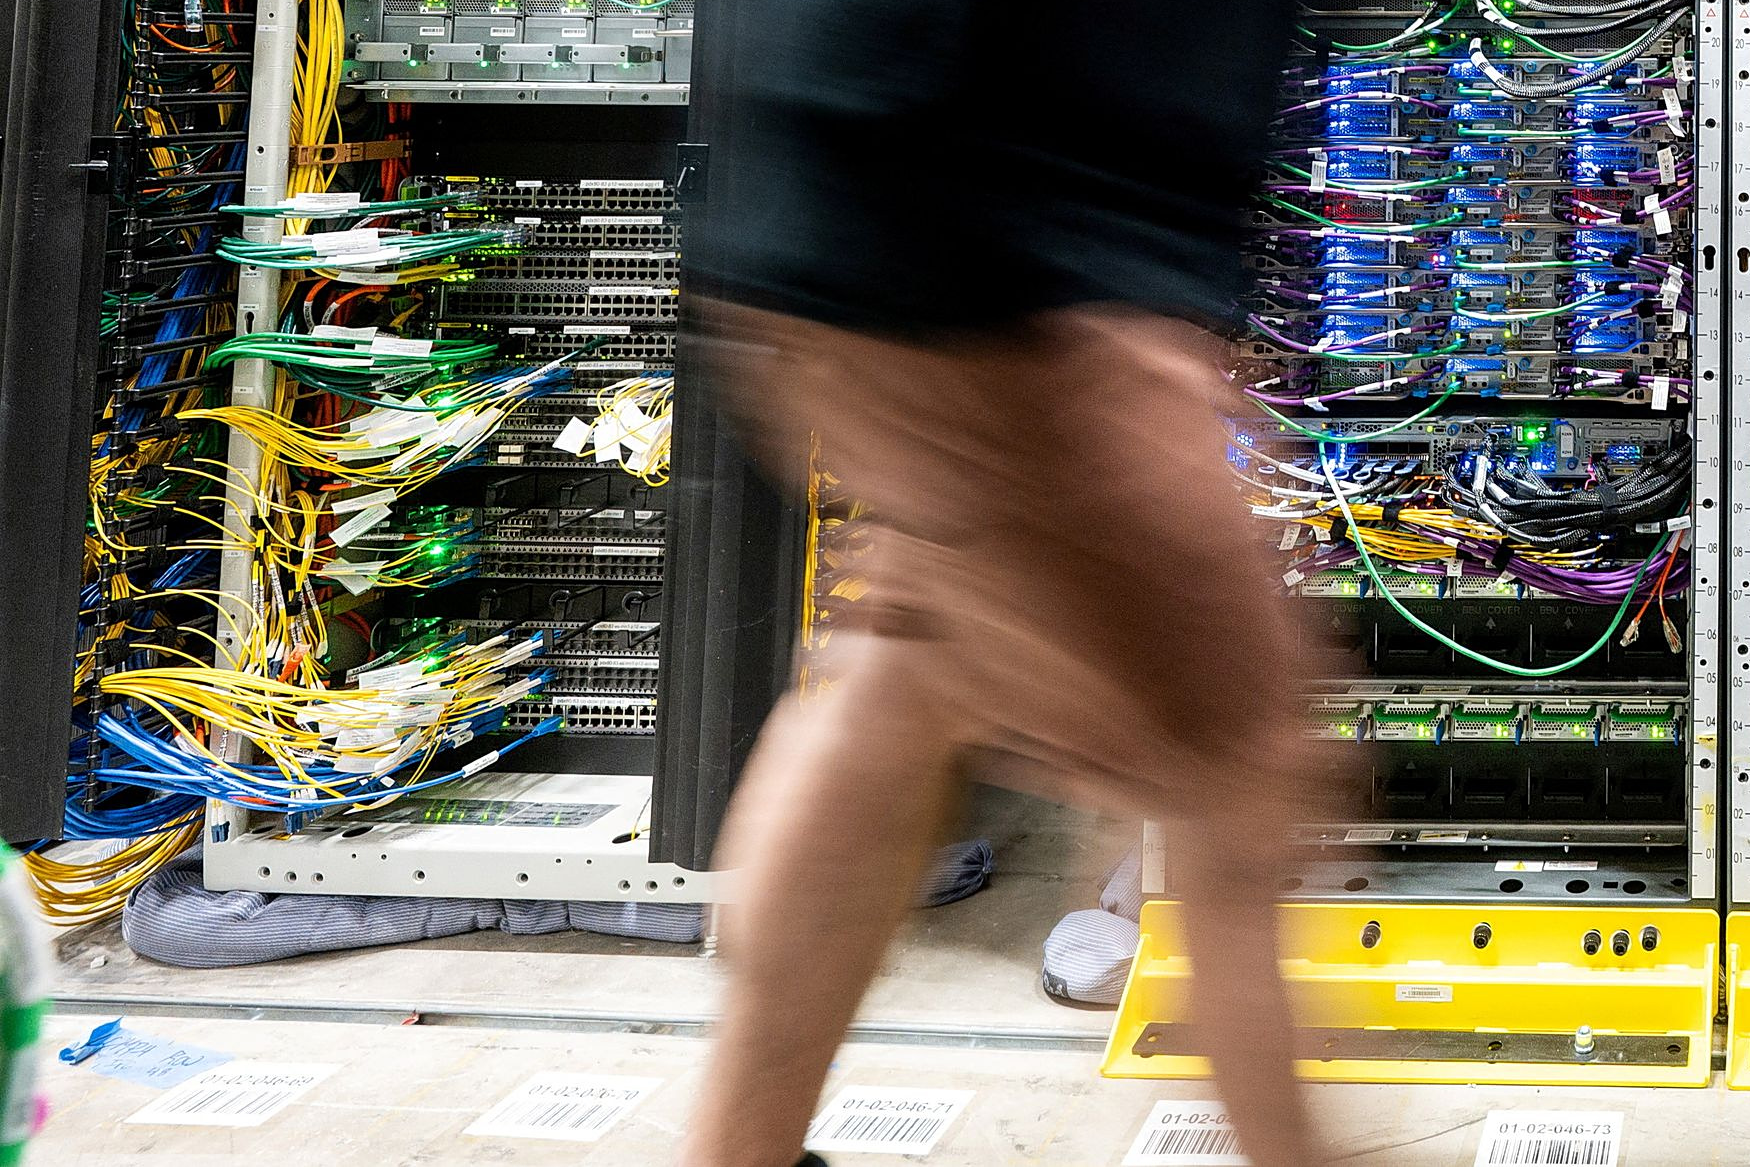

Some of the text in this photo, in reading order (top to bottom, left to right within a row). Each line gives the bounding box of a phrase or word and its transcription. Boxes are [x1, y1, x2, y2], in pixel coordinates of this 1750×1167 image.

[1711, 37, 1721, 48] 20
[1735, 38, 1744, 49] 20
[1712, 78, 1720, 89] 19
[1735, 78, 1744, 90] 19
[1735, 122, 1744, 132] 18
[1710, 162, 1720, 172] 17
[1734, 163, 1743, 174] 17
[1710, 204, 1719, 214] 16
[1734, 206, 1743, 216] 16
[1710, 288, 1718, 298] 14
[1734, 290, 1743, 300] 14
[1710, 330, 1718, 341] 13
[1734, 332, 1743, 343] 13
[1734, 374, 1743, 386] 12
[1711, 414, 1719, 425] 11
[1734, 417, 1742, 428] 11
[1710, 456, 1718, 468] 10
[1734, 460, 1743, 471] 10
[1733, 502, 1744, 514] 09
[1708, 542, 1718, 554] 08
[1733, 546, 1744, 558] 08
[1707, 585, 1718, 597] 07
[1732, 589, 1743, 601] 07
[1706, 628, 1717, 640] 06
[1706, 672, 1716, 684] 05
[1732, 676, 1743, 688] 05
[1706, 716, 1716, 727] 04
[1733, 720, 1743, 732] 04
[1704, 804, 1715, 816] 02
[1733, 808, 1744, 820] 02
[1706, 848, 1715, 858] 01
[1733, 852, 1742, 864] 01
[842, 1099, 954, 1114] 01-02-046-71
[1499, 1123, 1612, 1135] 01-02-046-73
